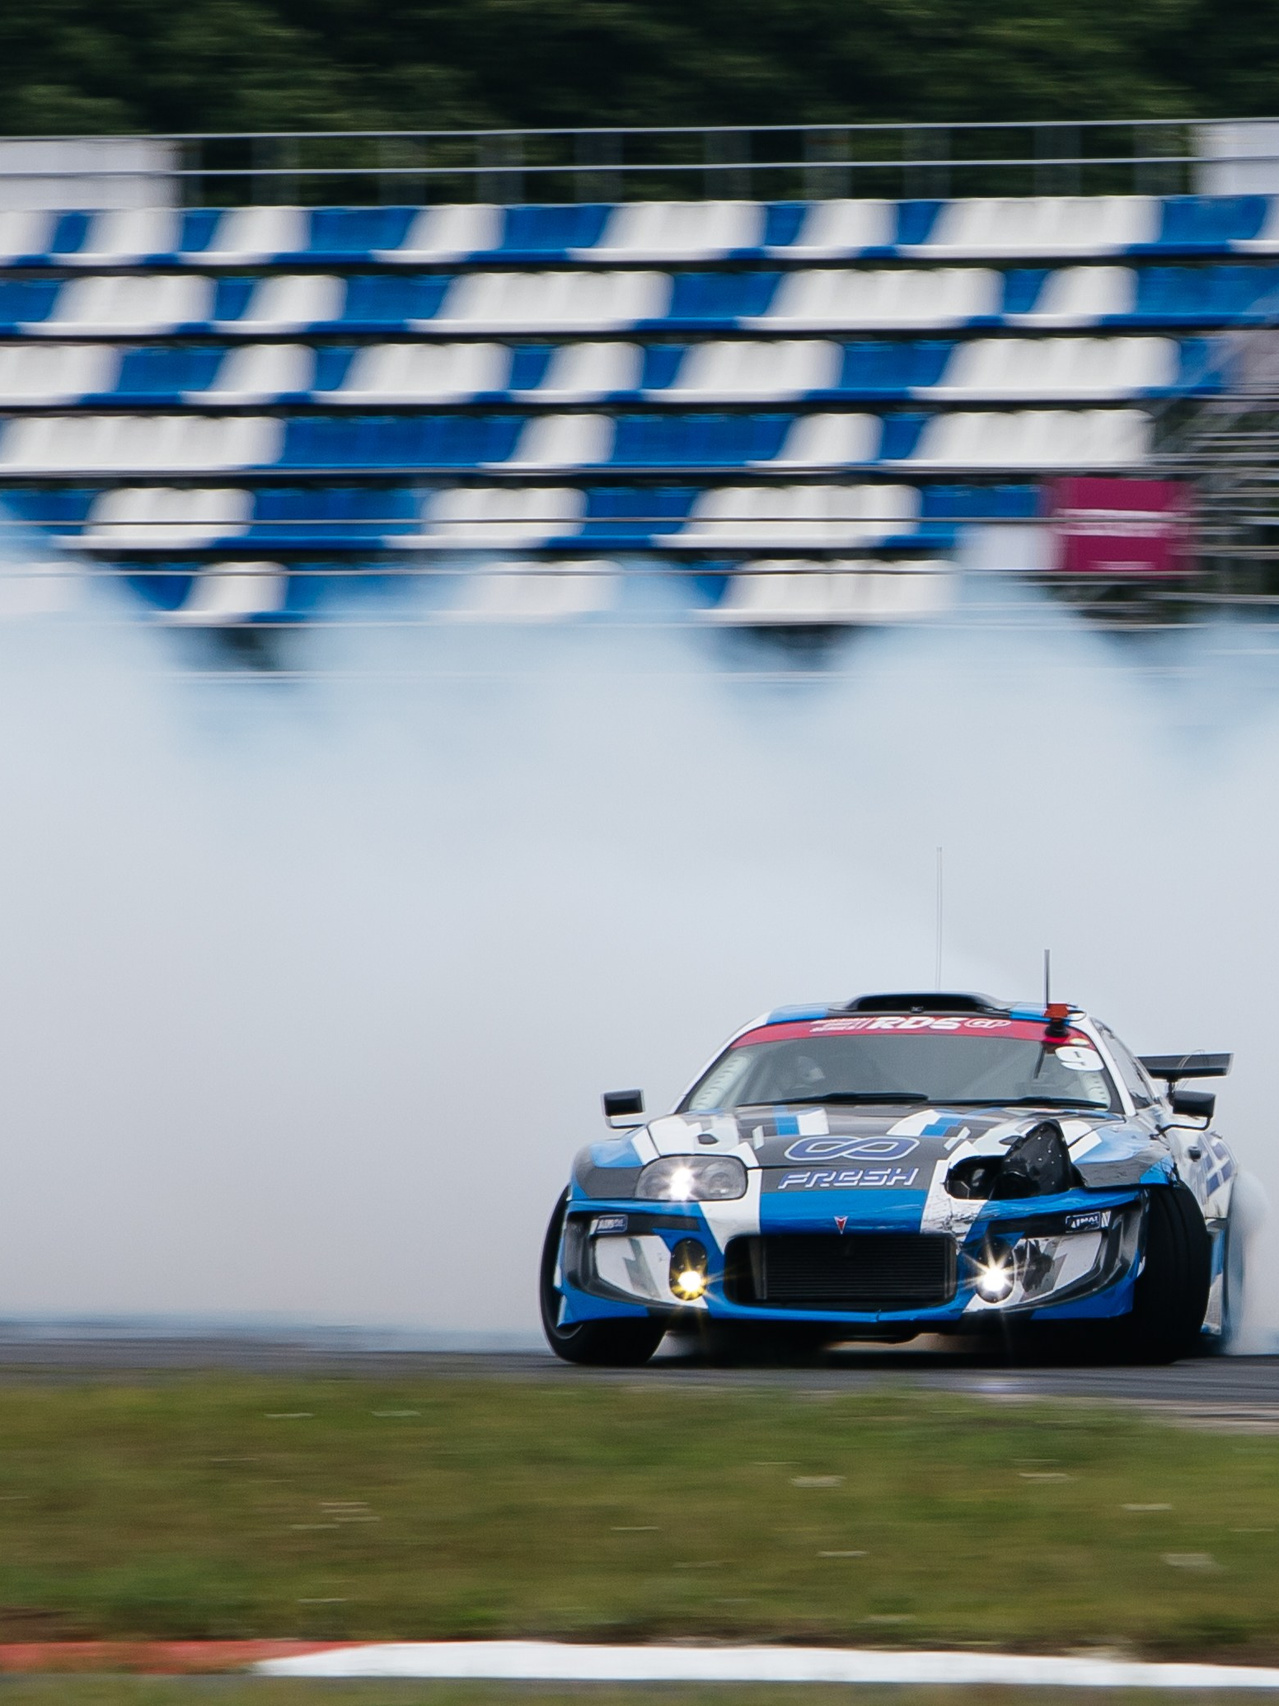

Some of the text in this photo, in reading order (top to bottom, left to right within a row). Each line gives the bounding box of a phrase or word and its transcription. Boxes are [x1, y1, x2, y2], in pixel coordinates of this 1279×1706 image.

[867, 1016, 967, 1030] RDS
[967, 1019, 1009, 1029] GP
[1055, 1046, 1104, 1071] 9
